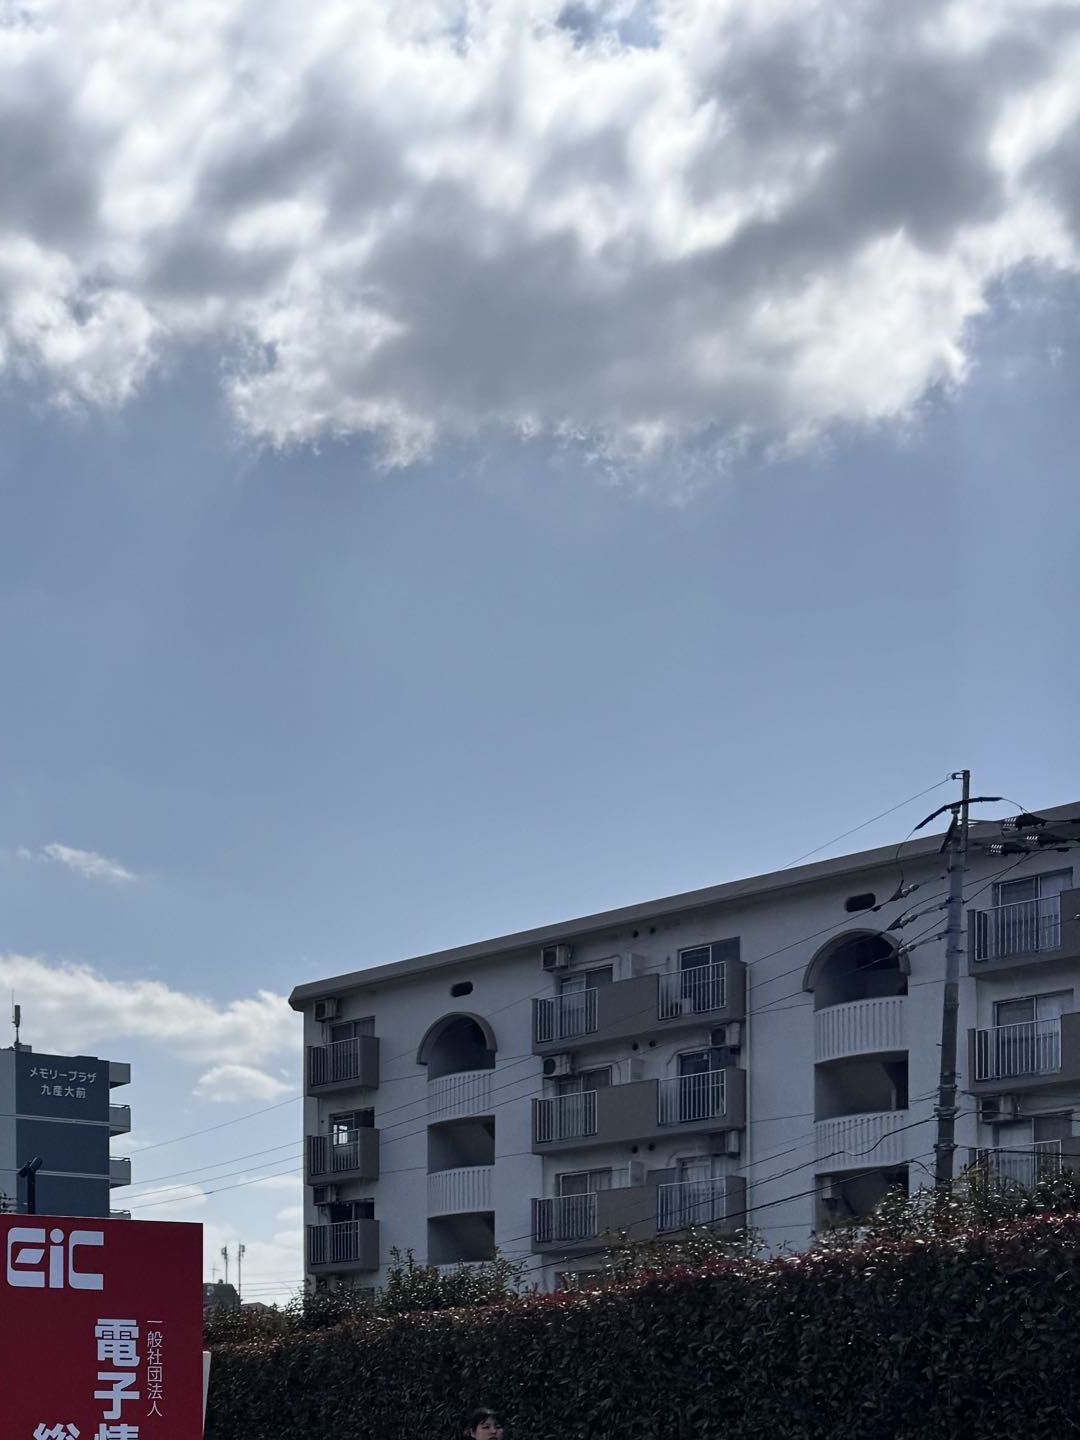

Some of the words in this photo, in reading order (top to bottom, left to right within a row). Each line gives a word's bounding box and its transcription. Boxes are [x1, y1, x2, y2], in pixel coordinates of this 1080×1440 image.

[29, 1067, 97, 1083] メモリープラザ
[40, 1084, 86, 1099] 九産大前
[146, 1320, 163, 1417] 一般社団法人
